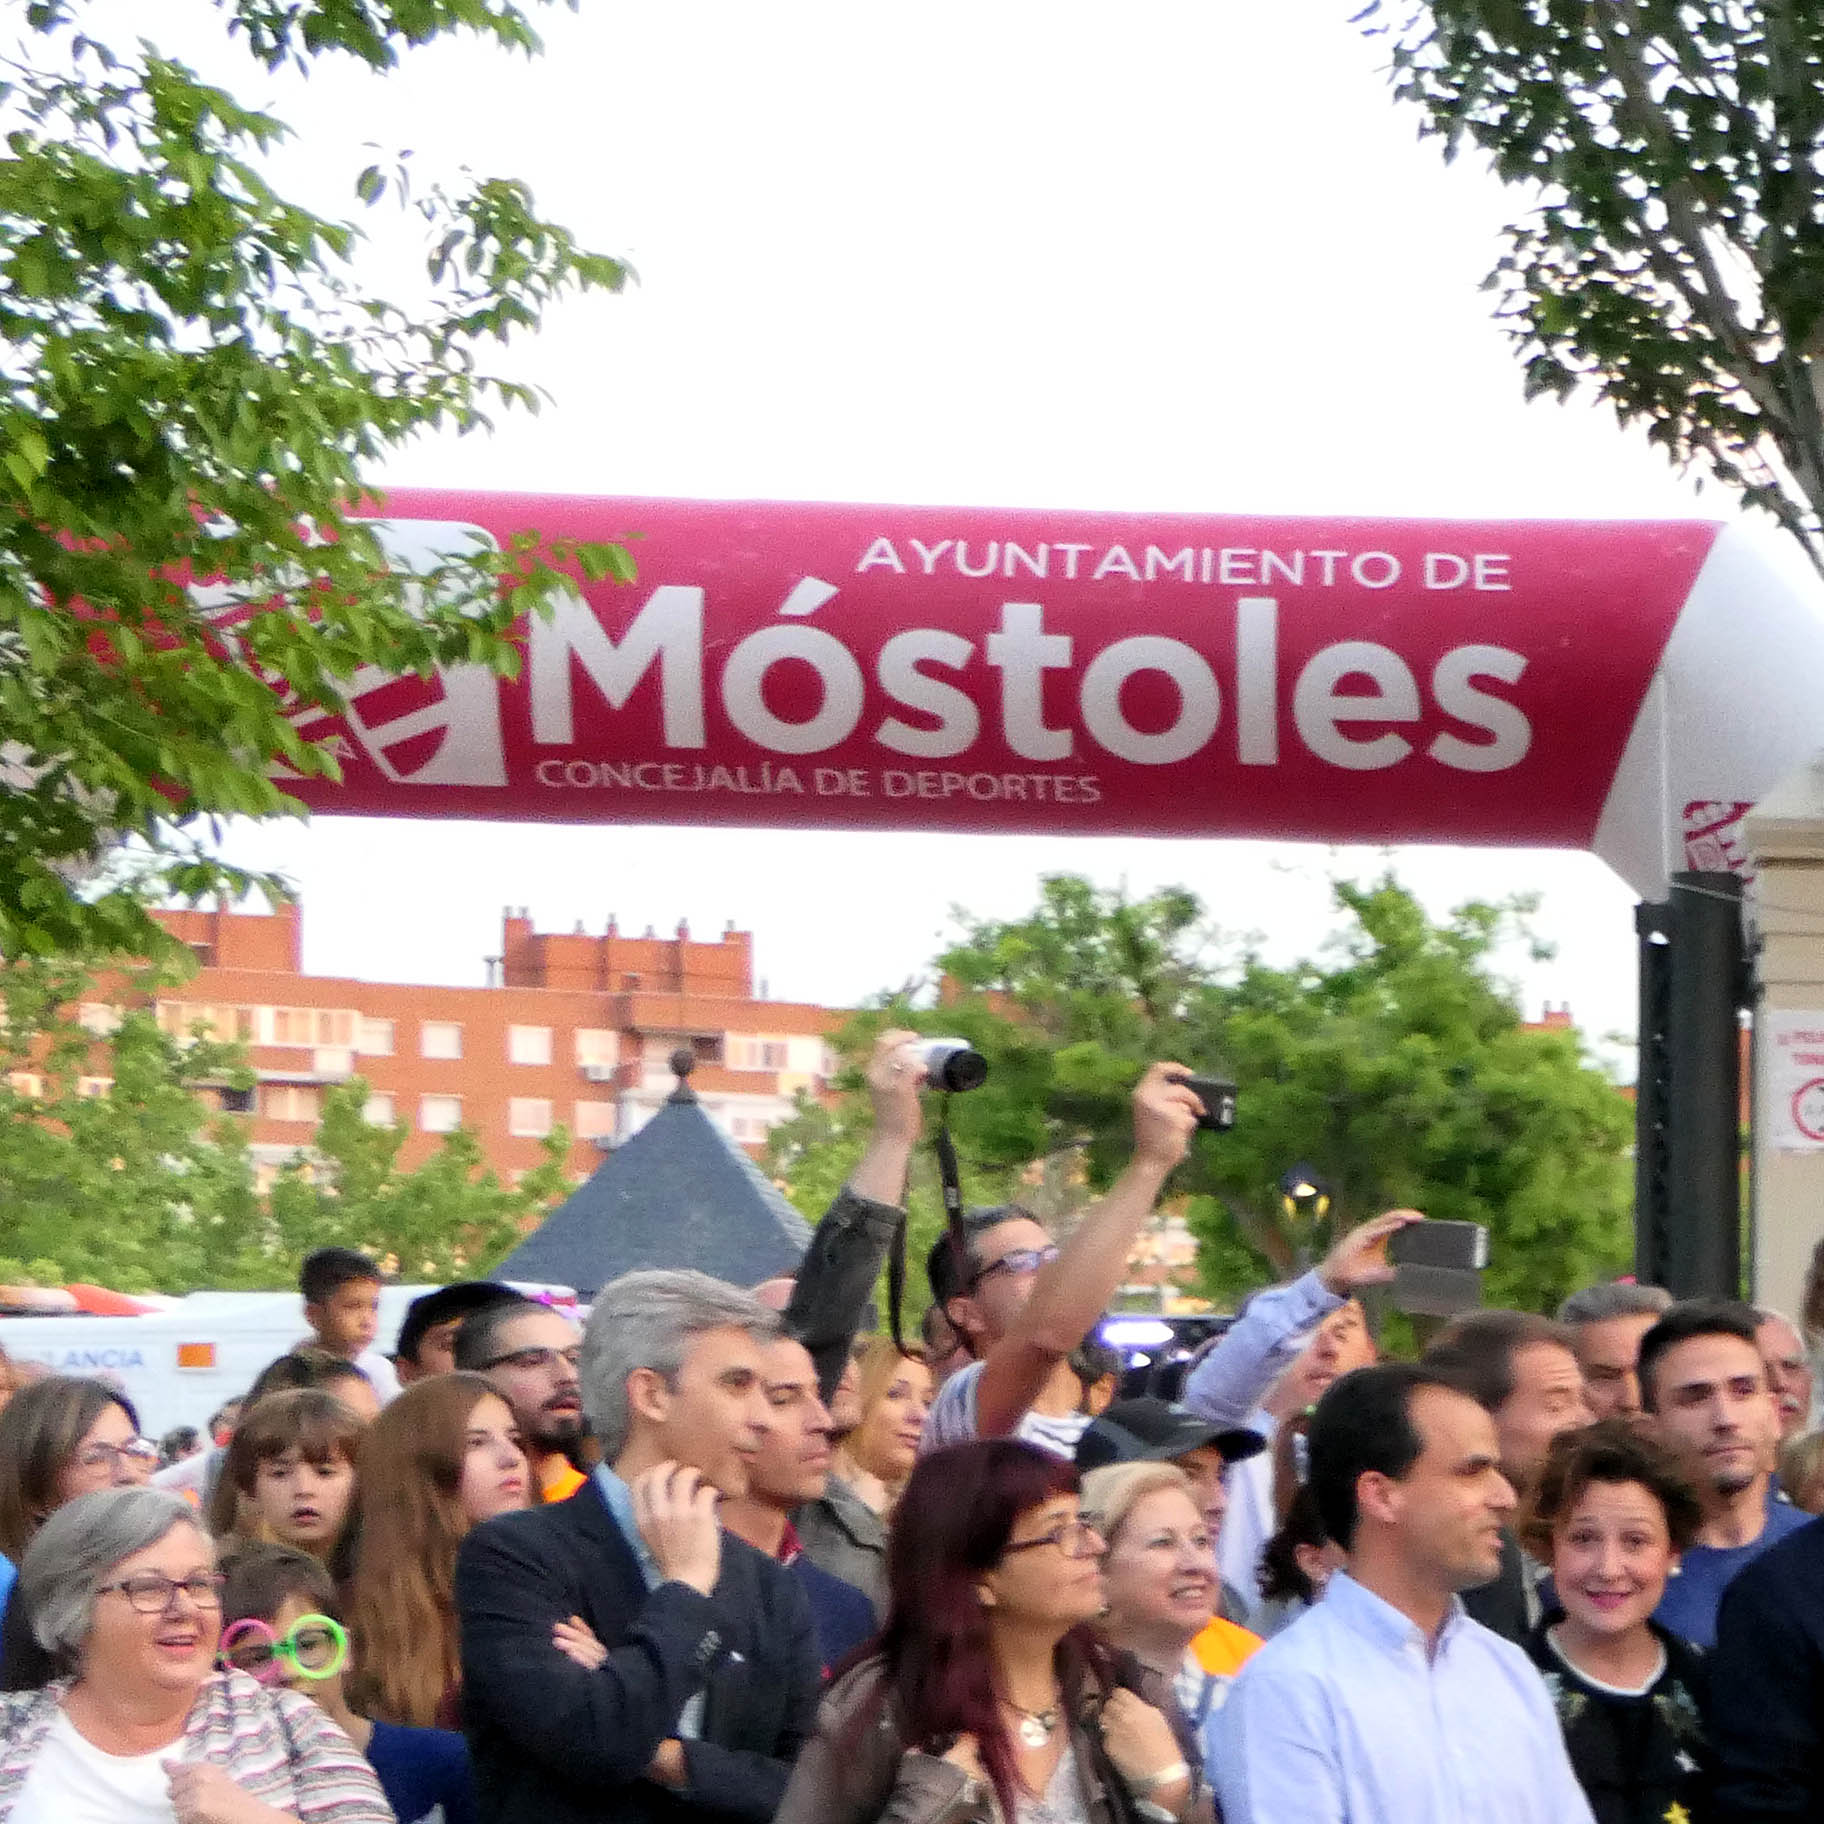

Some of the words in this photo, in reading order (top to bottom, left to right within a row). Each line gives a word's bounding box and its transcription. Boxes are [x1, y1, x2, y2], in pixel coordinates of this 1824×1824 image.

[856, 536, 1402, 590] AYUNTAMIENTO
[1422, 552, 1512, 592] DE
[527, 575, 1533, 773] Móstoles
[534, 759, 803, 795] CONCEJALÍA
[815, 766, 872, 798] DE
[883, 768, 1101, 804] DEPORTES
[50, 1348, 145, 1369] LANCIA
